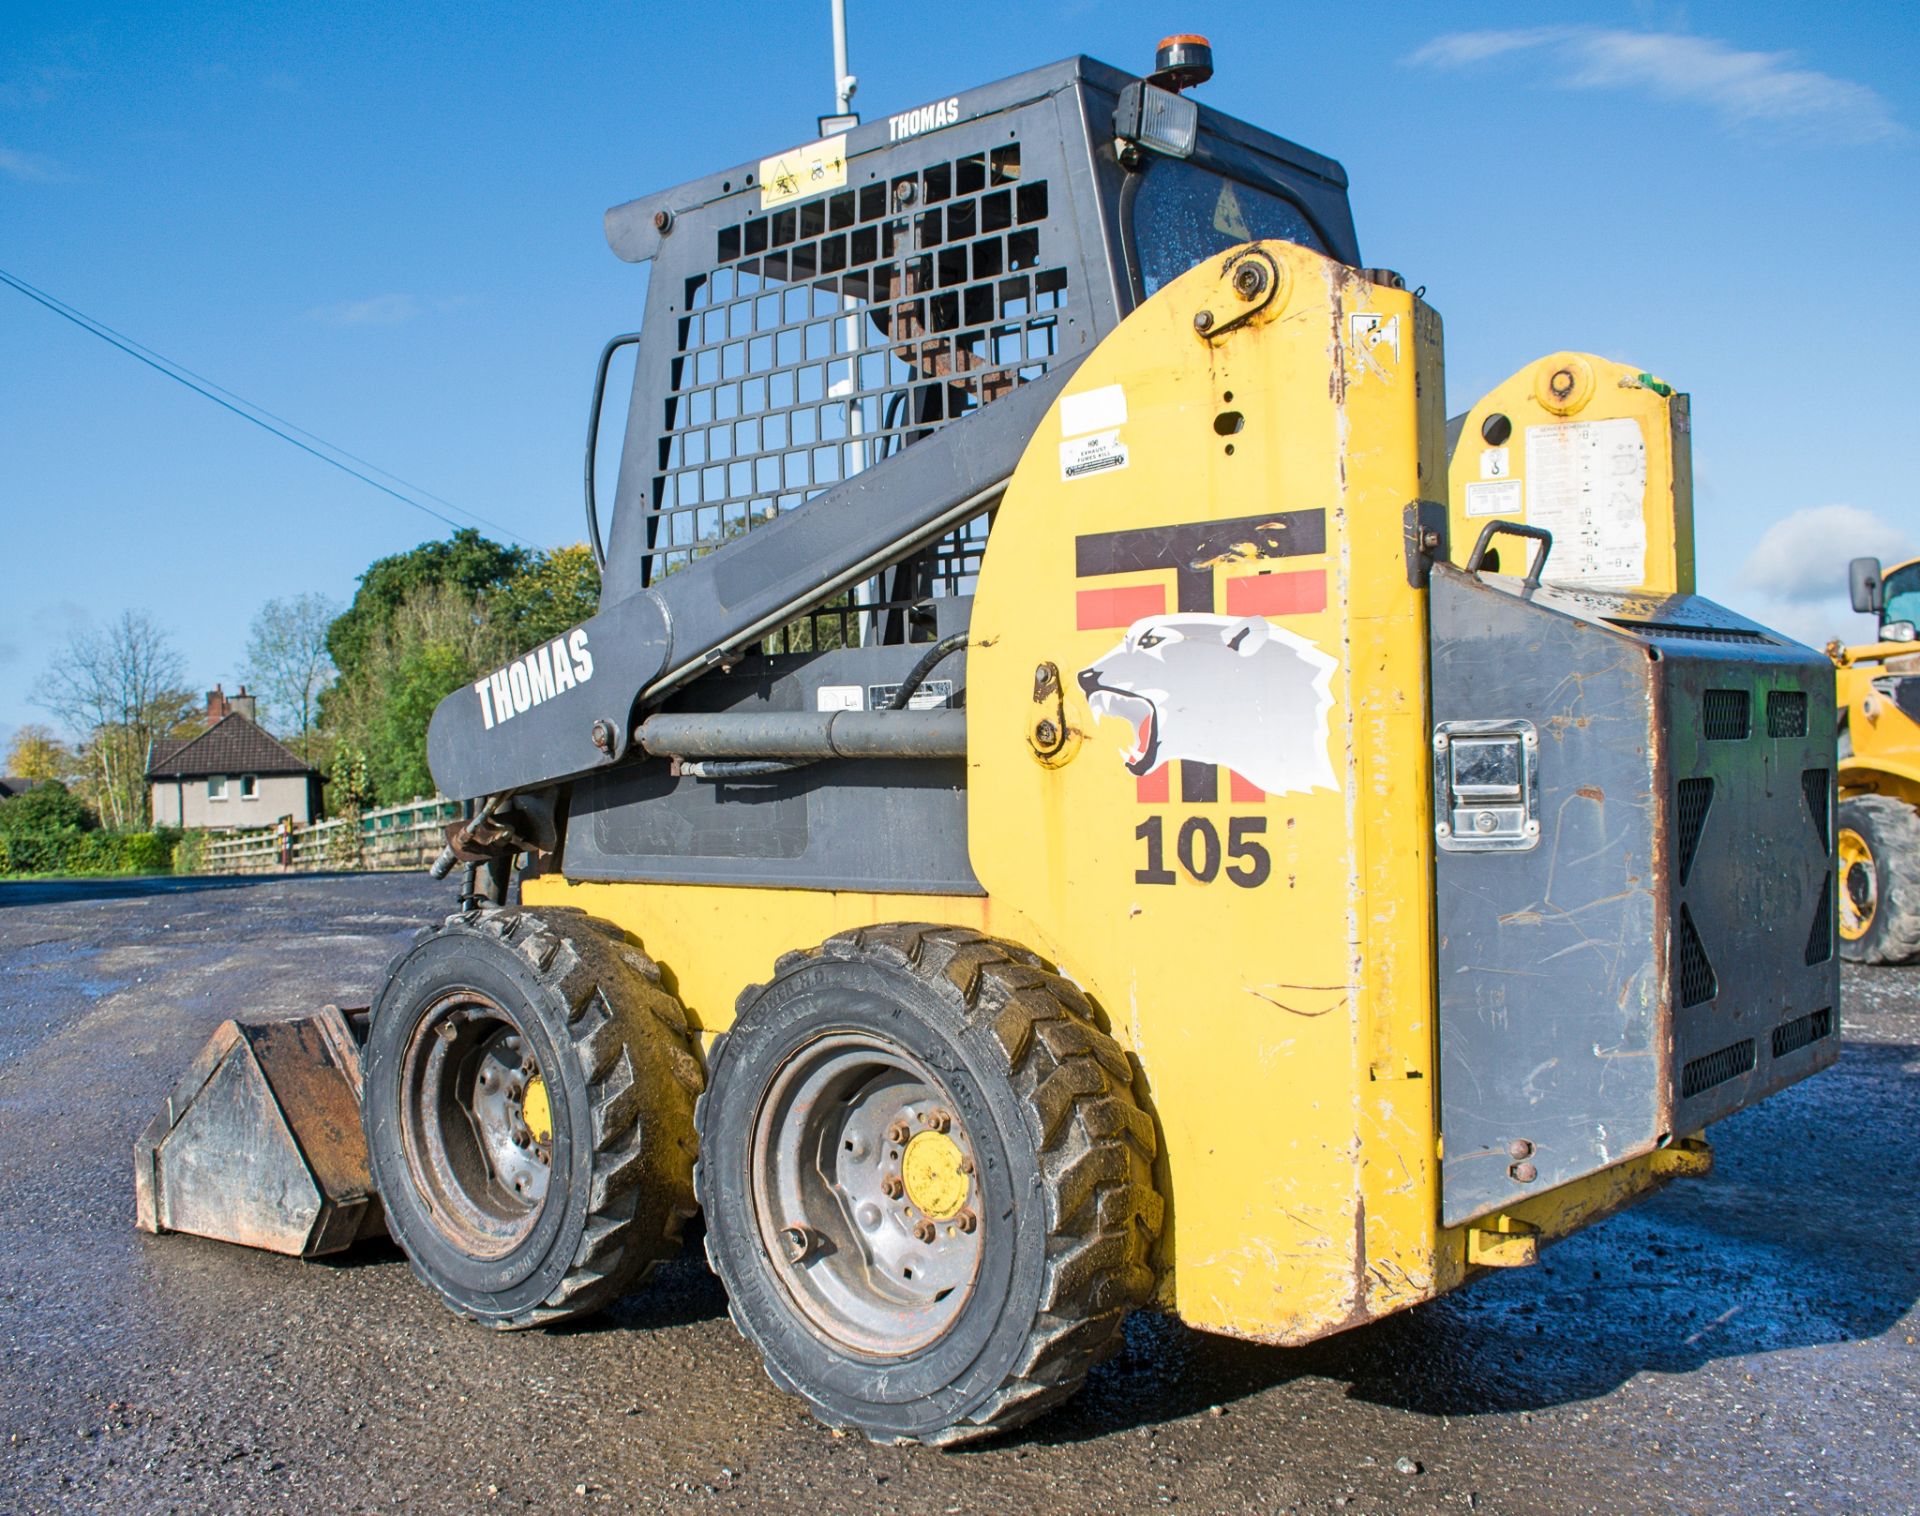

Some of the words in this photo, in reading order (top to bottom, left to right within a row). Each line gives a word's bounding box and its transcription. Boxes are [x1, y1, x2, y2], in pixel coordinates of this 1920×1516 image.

[889, 97, 959, 141] THOMAS
[474, 628, 594, 731] THOMAS
[1135, 815, 1271, 889] 105
